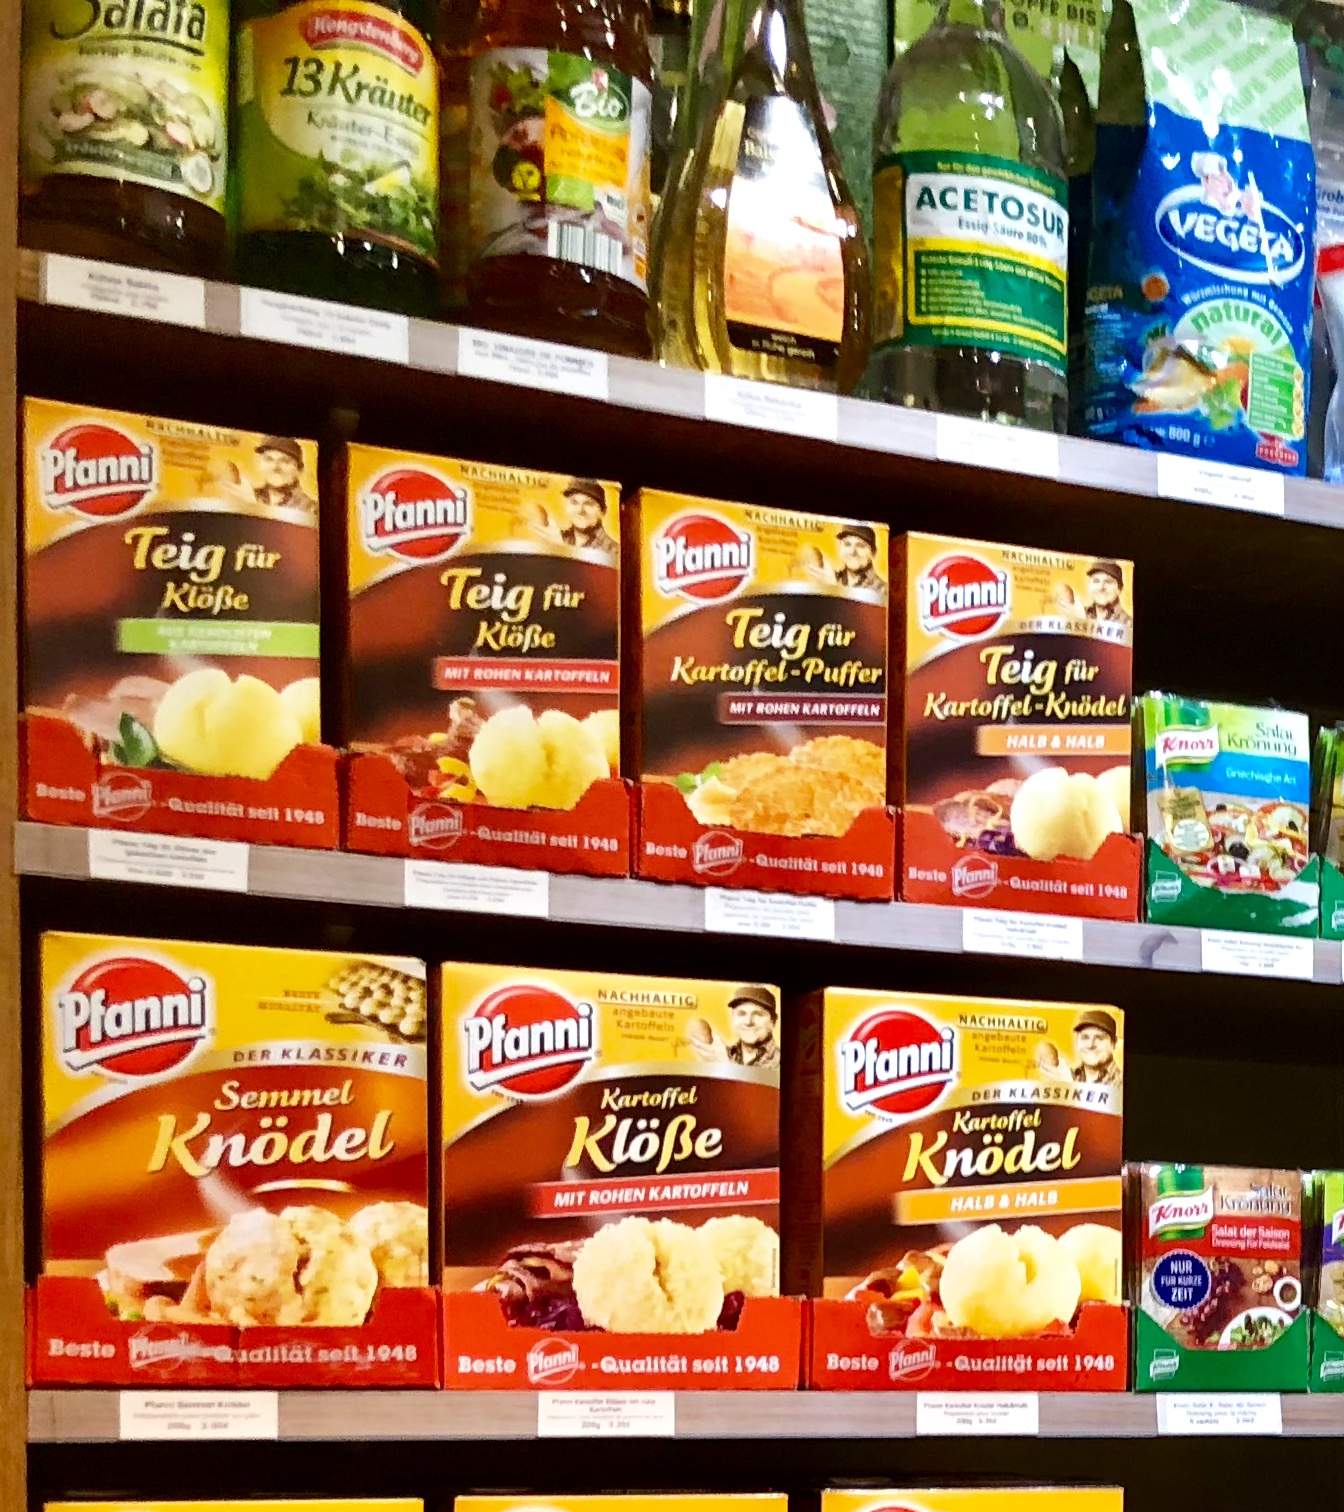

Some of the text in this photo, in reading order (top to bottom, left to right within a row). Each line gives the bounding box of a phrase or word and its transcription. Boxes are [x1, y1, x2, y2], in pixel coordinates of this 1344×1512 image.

[915, 186, 1065, 244] ACETOSUR
[1168, 208, 1295, 264] VEGETA
[1191, 302, 1284, 344] natural
[124, 526, 281, 583] Teig für
[162, 580, 250, 613] Klöße
[441, 567, 586, 620] Teig für
[475, 621, 557, 652] Klöße
[725, 607, 857, 660] Teig für
[443, 666, 611, 685] MIT ROHEN KARTOFFELN
[671, 656, 883, 688] Kartoffel-Puffer
[923, 692, 1128, 723] Kartoffel-Knödel
[1162, 735, 1215, 752] Knorr
[59, 976, 208, 1050] Pfanni
[597, 988, 697, 1008] NACHHALTIG
[464, 1003, 594, 1072] Pfanni
[232, 1047, 409, 1070] DER KLASSIKER
[841, 1024, 955, 1088] Pfanni
[213, 1080, 355, 1112] Semmel
[600, 1086, 698, 1112] Kartoffel
[971, 1088, 1110, 1106] DER KLASSIKER
[952, 1108, 1041, 1134] Kartoffel
[147, 1108, 394, 1178] Knödel
[566, 1112, 723, 1175] Klöße
[902, 1129, 1082, 1186] Knödel
[553, 1179, 750, 1208] MIT ROHEN KARTOFFELN
[950, 1189, 1058, 1212] HALB & HALB
[1169, 1259, 1193, 1274] NUR
[1171, 1287, 1194, 1301] ZEIT
[457, 1354, 517, 1374] Beste
[526, 1342, 580, 1377] Pfanni
[693, 1354, 731, 1374] seit
[734, 1354, 781, 1374] 1948
